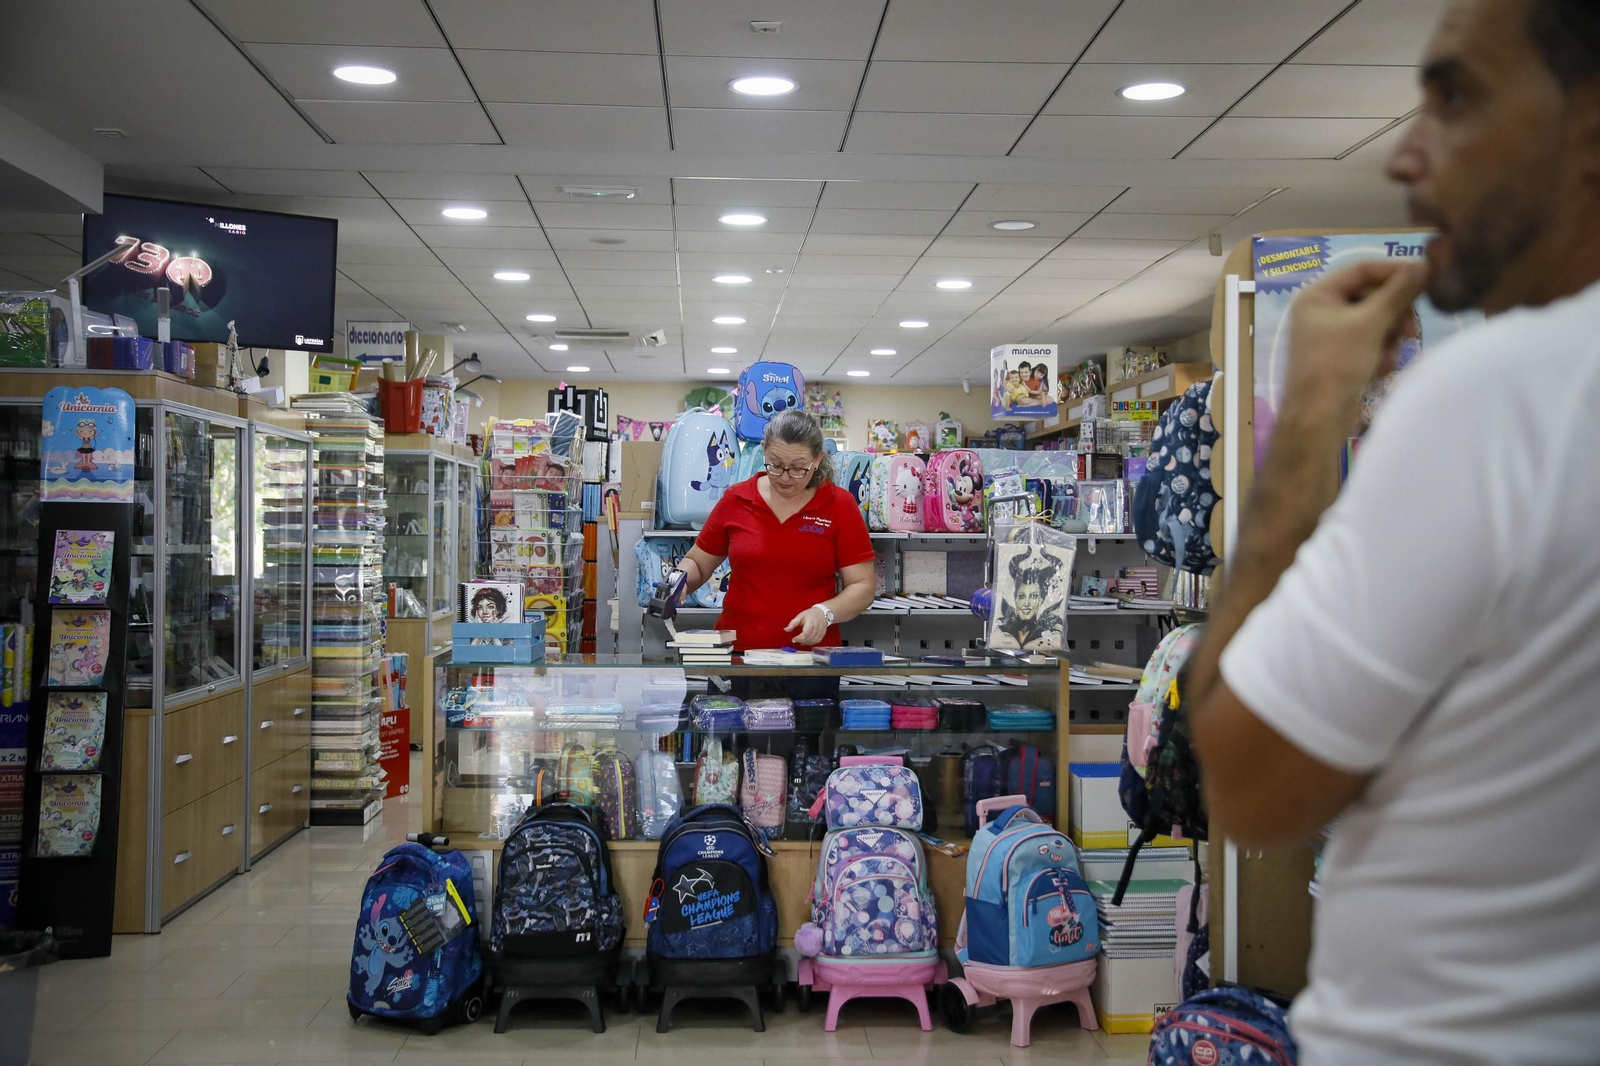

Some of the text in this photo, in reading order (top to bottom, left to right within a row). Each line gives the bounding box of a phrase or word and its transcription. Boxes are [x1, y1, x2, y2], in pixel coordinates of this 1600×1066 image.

[1257, 244, 1321, 267] ¡DESMONTABLE
[1262, 258, 1322, 278] Y SILENCIOSO!
[59, 402, 117, 414] Unicornia
[381, 715, 397, 726] APLI
[0, 774, 24, 782] XTRA
[681, 890, 740, 916] CHAMPIONS
[697, 889, 719, 901] UEFA
[690, 904, 734, 926] LEAGUE
